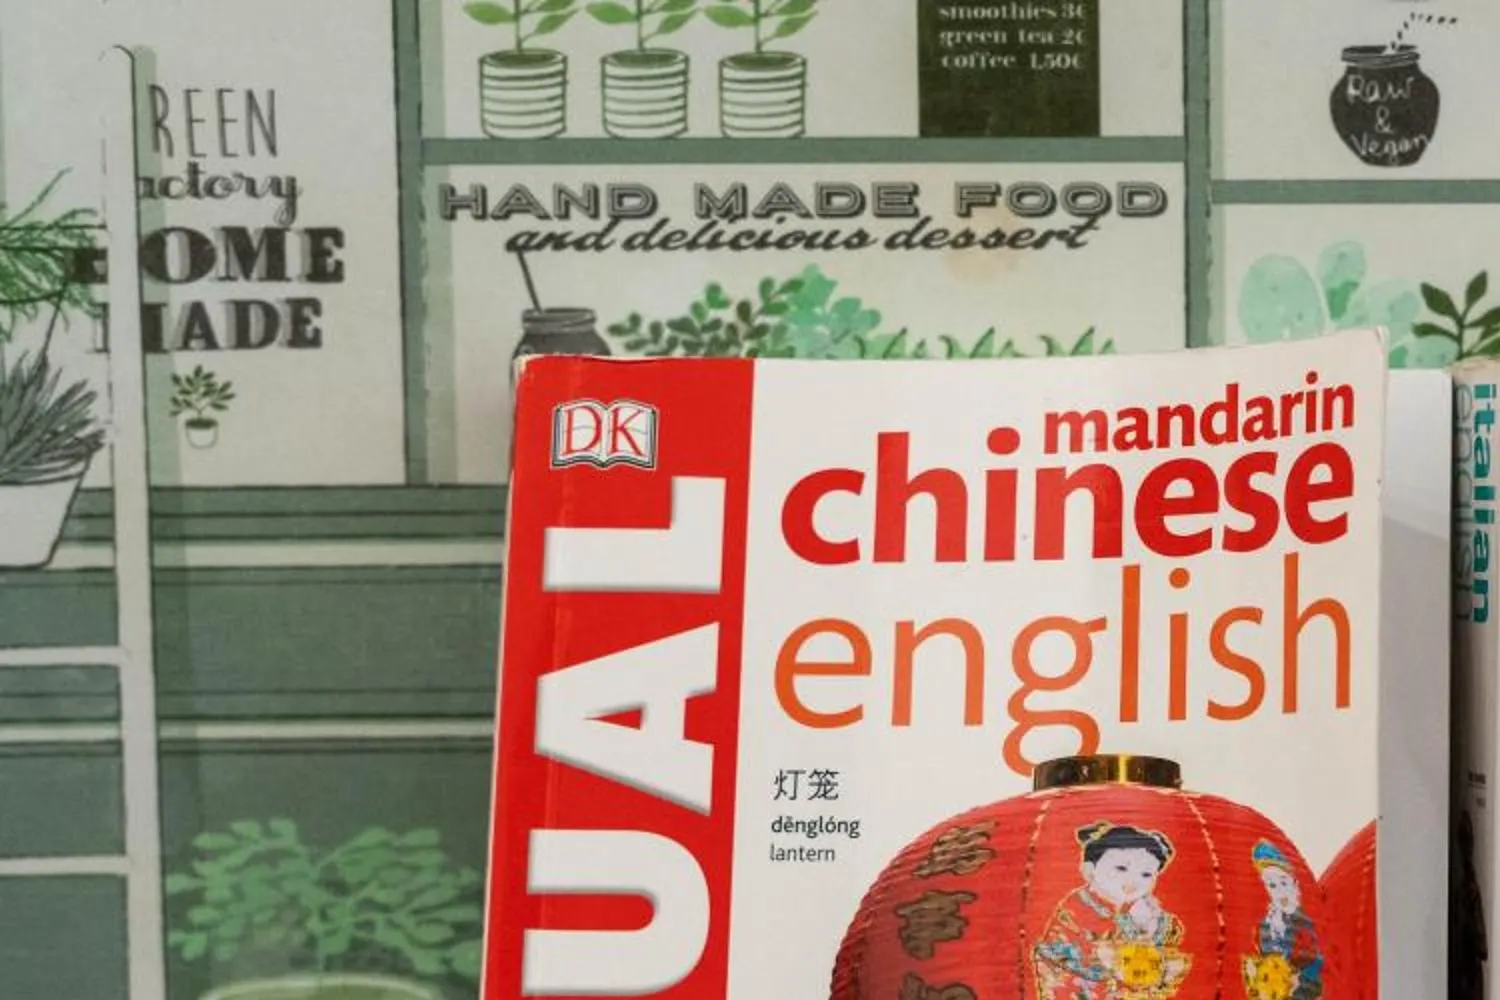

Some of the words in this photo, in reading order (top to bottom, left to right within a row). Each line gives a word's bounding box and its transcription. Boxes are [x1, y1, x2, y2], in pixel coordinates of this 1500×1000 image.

[939, 2, 1057, 20] smoothies
[939, 29, 1008, 48] green
[1018, 28, 1053, 45] tea
[941, 52, 1017, 69] coffee
[148, 84, 278, 158] REEN
[1375, 105, 1394, 134] &
[1350, 131, 1428, 166] Vegan
[137, 161, 303, 226] actory
[437, 182, 660, 221] HAND
[694, 181, 920, 220] MADE
[953, 181, 1168, 218] FOOD
[505, 217, 616, 252] and
[620, 217, 878, 252] delicious
[883, 214, 1101, 251] dessert
[561, 404, 646, 458] DK
[1043, 371, 1355, 455] mandarin
[780, 431, 1355, 565] chinese
[1472, 383, 1498, 624] italian
[773, 553, 1352, 777] english
[773, 769, 840, 801] 灯笼
[769, 843, 836, 862] lantern
